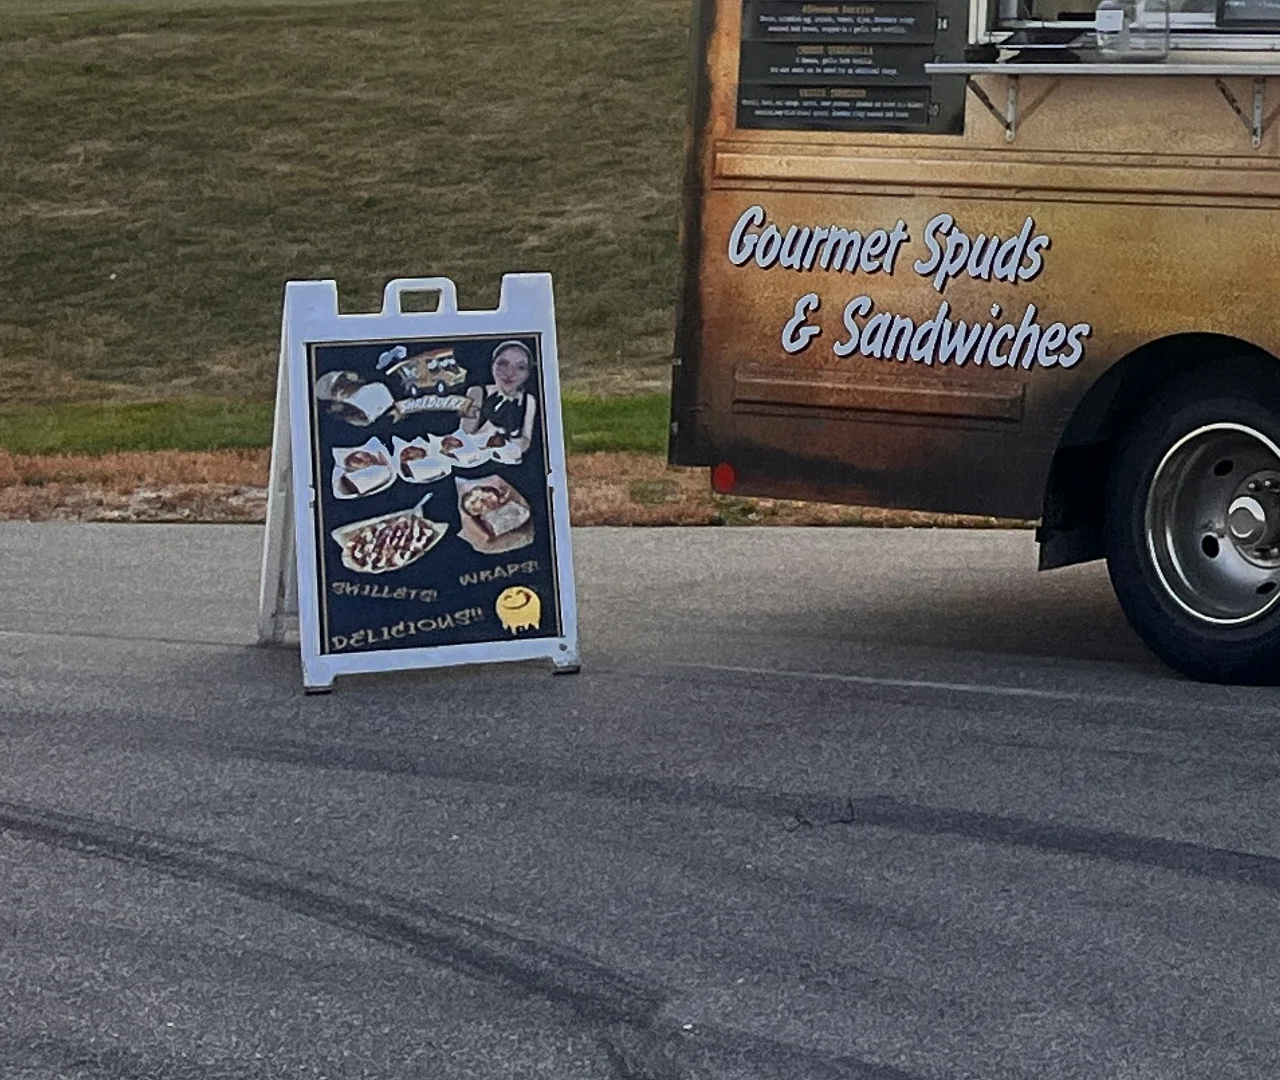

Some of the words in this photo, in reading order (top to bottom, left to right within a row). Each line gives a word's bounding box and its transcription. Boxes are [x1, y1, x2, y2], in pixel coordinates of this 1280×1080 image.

[728, 205, 910, 274] Gourmet
[913, 213, 1050, 293] Spuds
[780, 293, 822, 354] &
[833, 295, 1092, 370] Sandwiches
